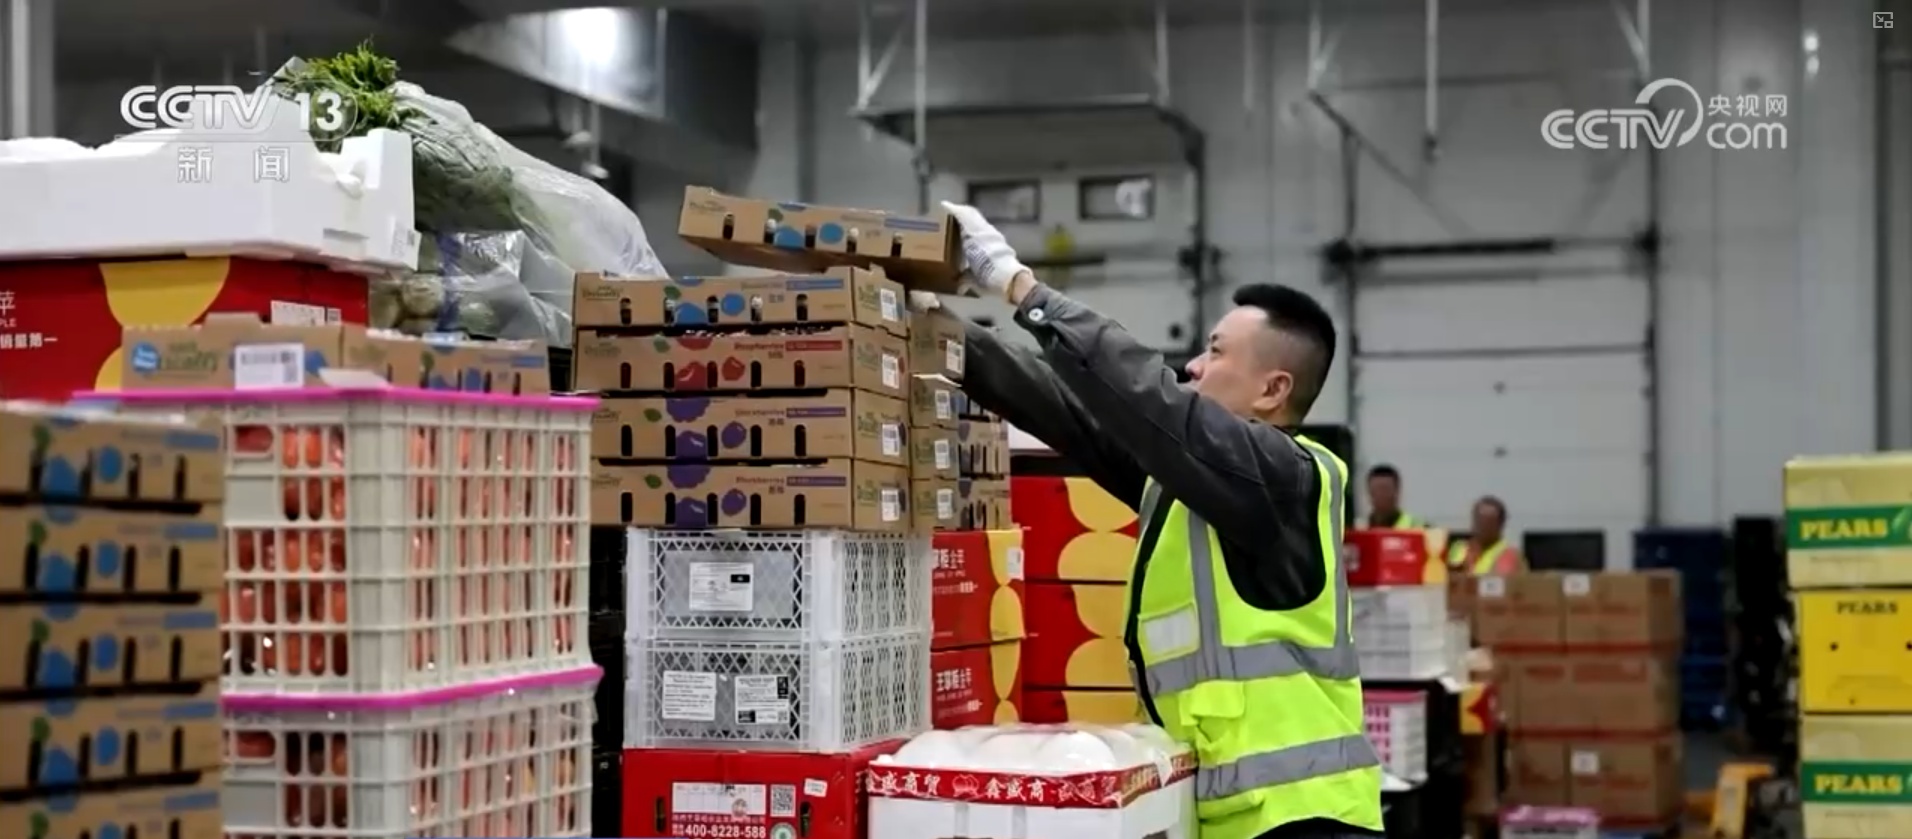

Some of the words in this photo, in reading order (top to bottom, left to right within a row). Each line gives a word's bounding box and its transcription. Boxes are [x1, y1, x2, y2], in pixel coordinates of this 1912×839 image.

[1801, 518, 1887, 540] PEARS
[1836, 600, 1898, 615] PEARS
[1814, 774, 1902, 796] PEARS
[685, 823, 766, 838] 400-8228-588
